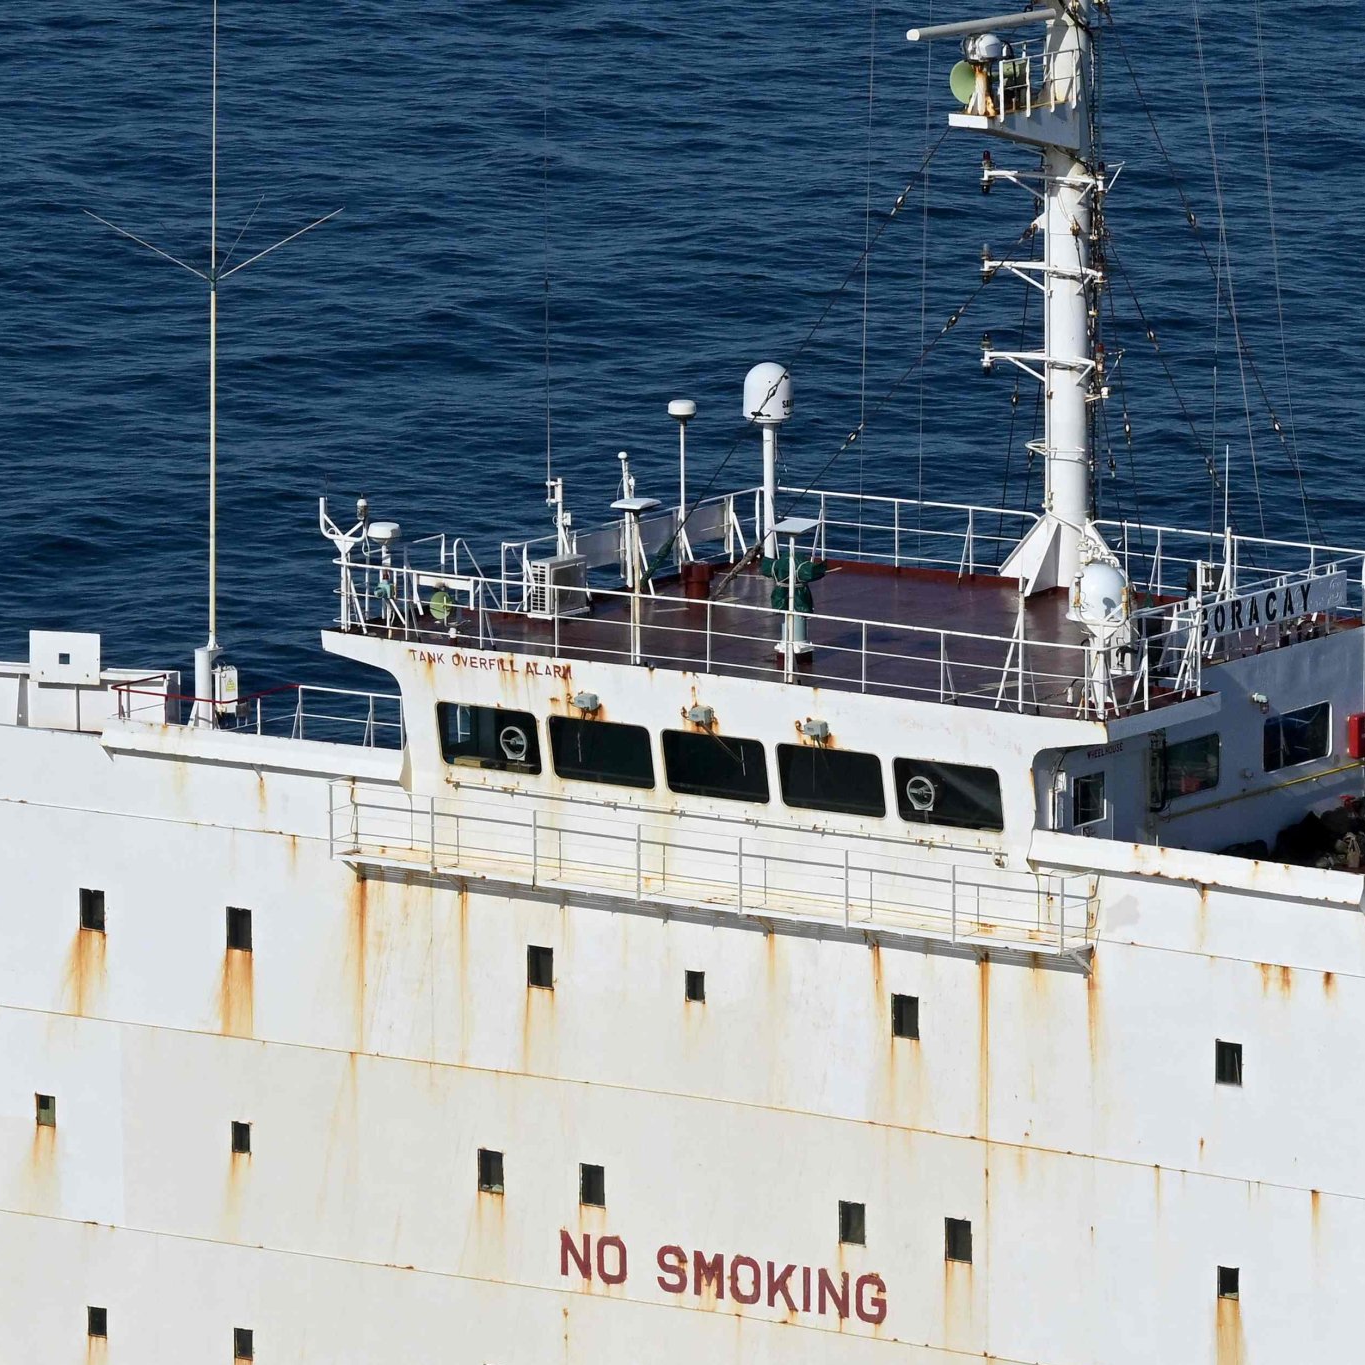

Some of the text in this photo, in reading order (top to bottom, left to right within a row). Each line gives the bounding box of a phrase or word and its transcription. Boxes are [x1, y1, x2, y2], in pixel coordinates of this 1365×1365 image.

[408, 648, 573, 680] TANK OVERFILL ALARM
[559, 1229, 889, 1325] NO SMOKING
